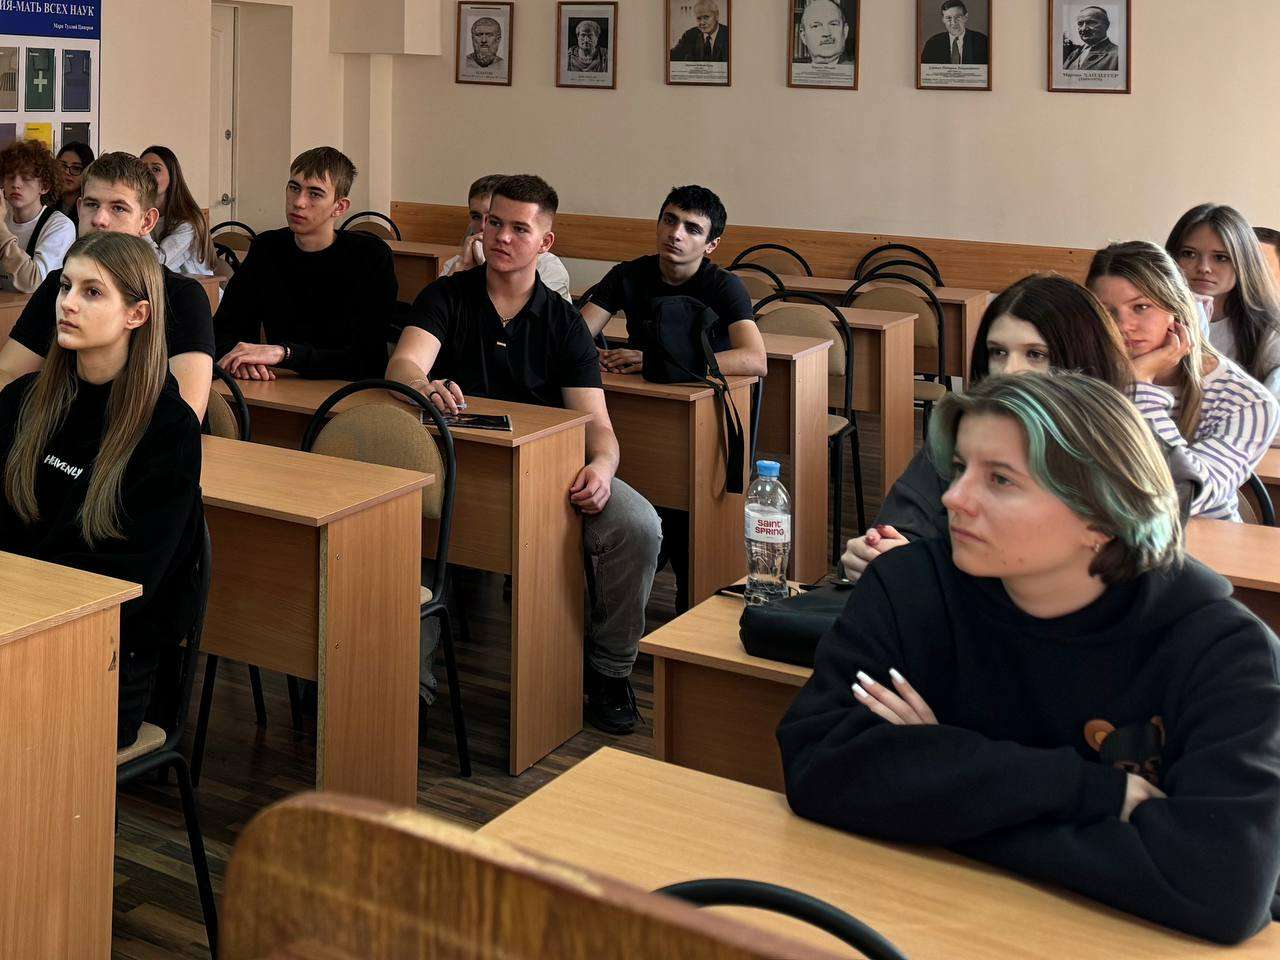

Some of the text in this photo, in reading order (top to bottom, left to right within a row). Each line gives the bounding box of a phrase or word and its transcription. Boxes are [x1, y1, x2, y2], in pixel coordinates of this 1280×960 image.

[44, 2, 68, 15] ВСЕХ
[70, 4, 95, 17] НАУК
[43, 454, 84, 480] HEAVENLY
